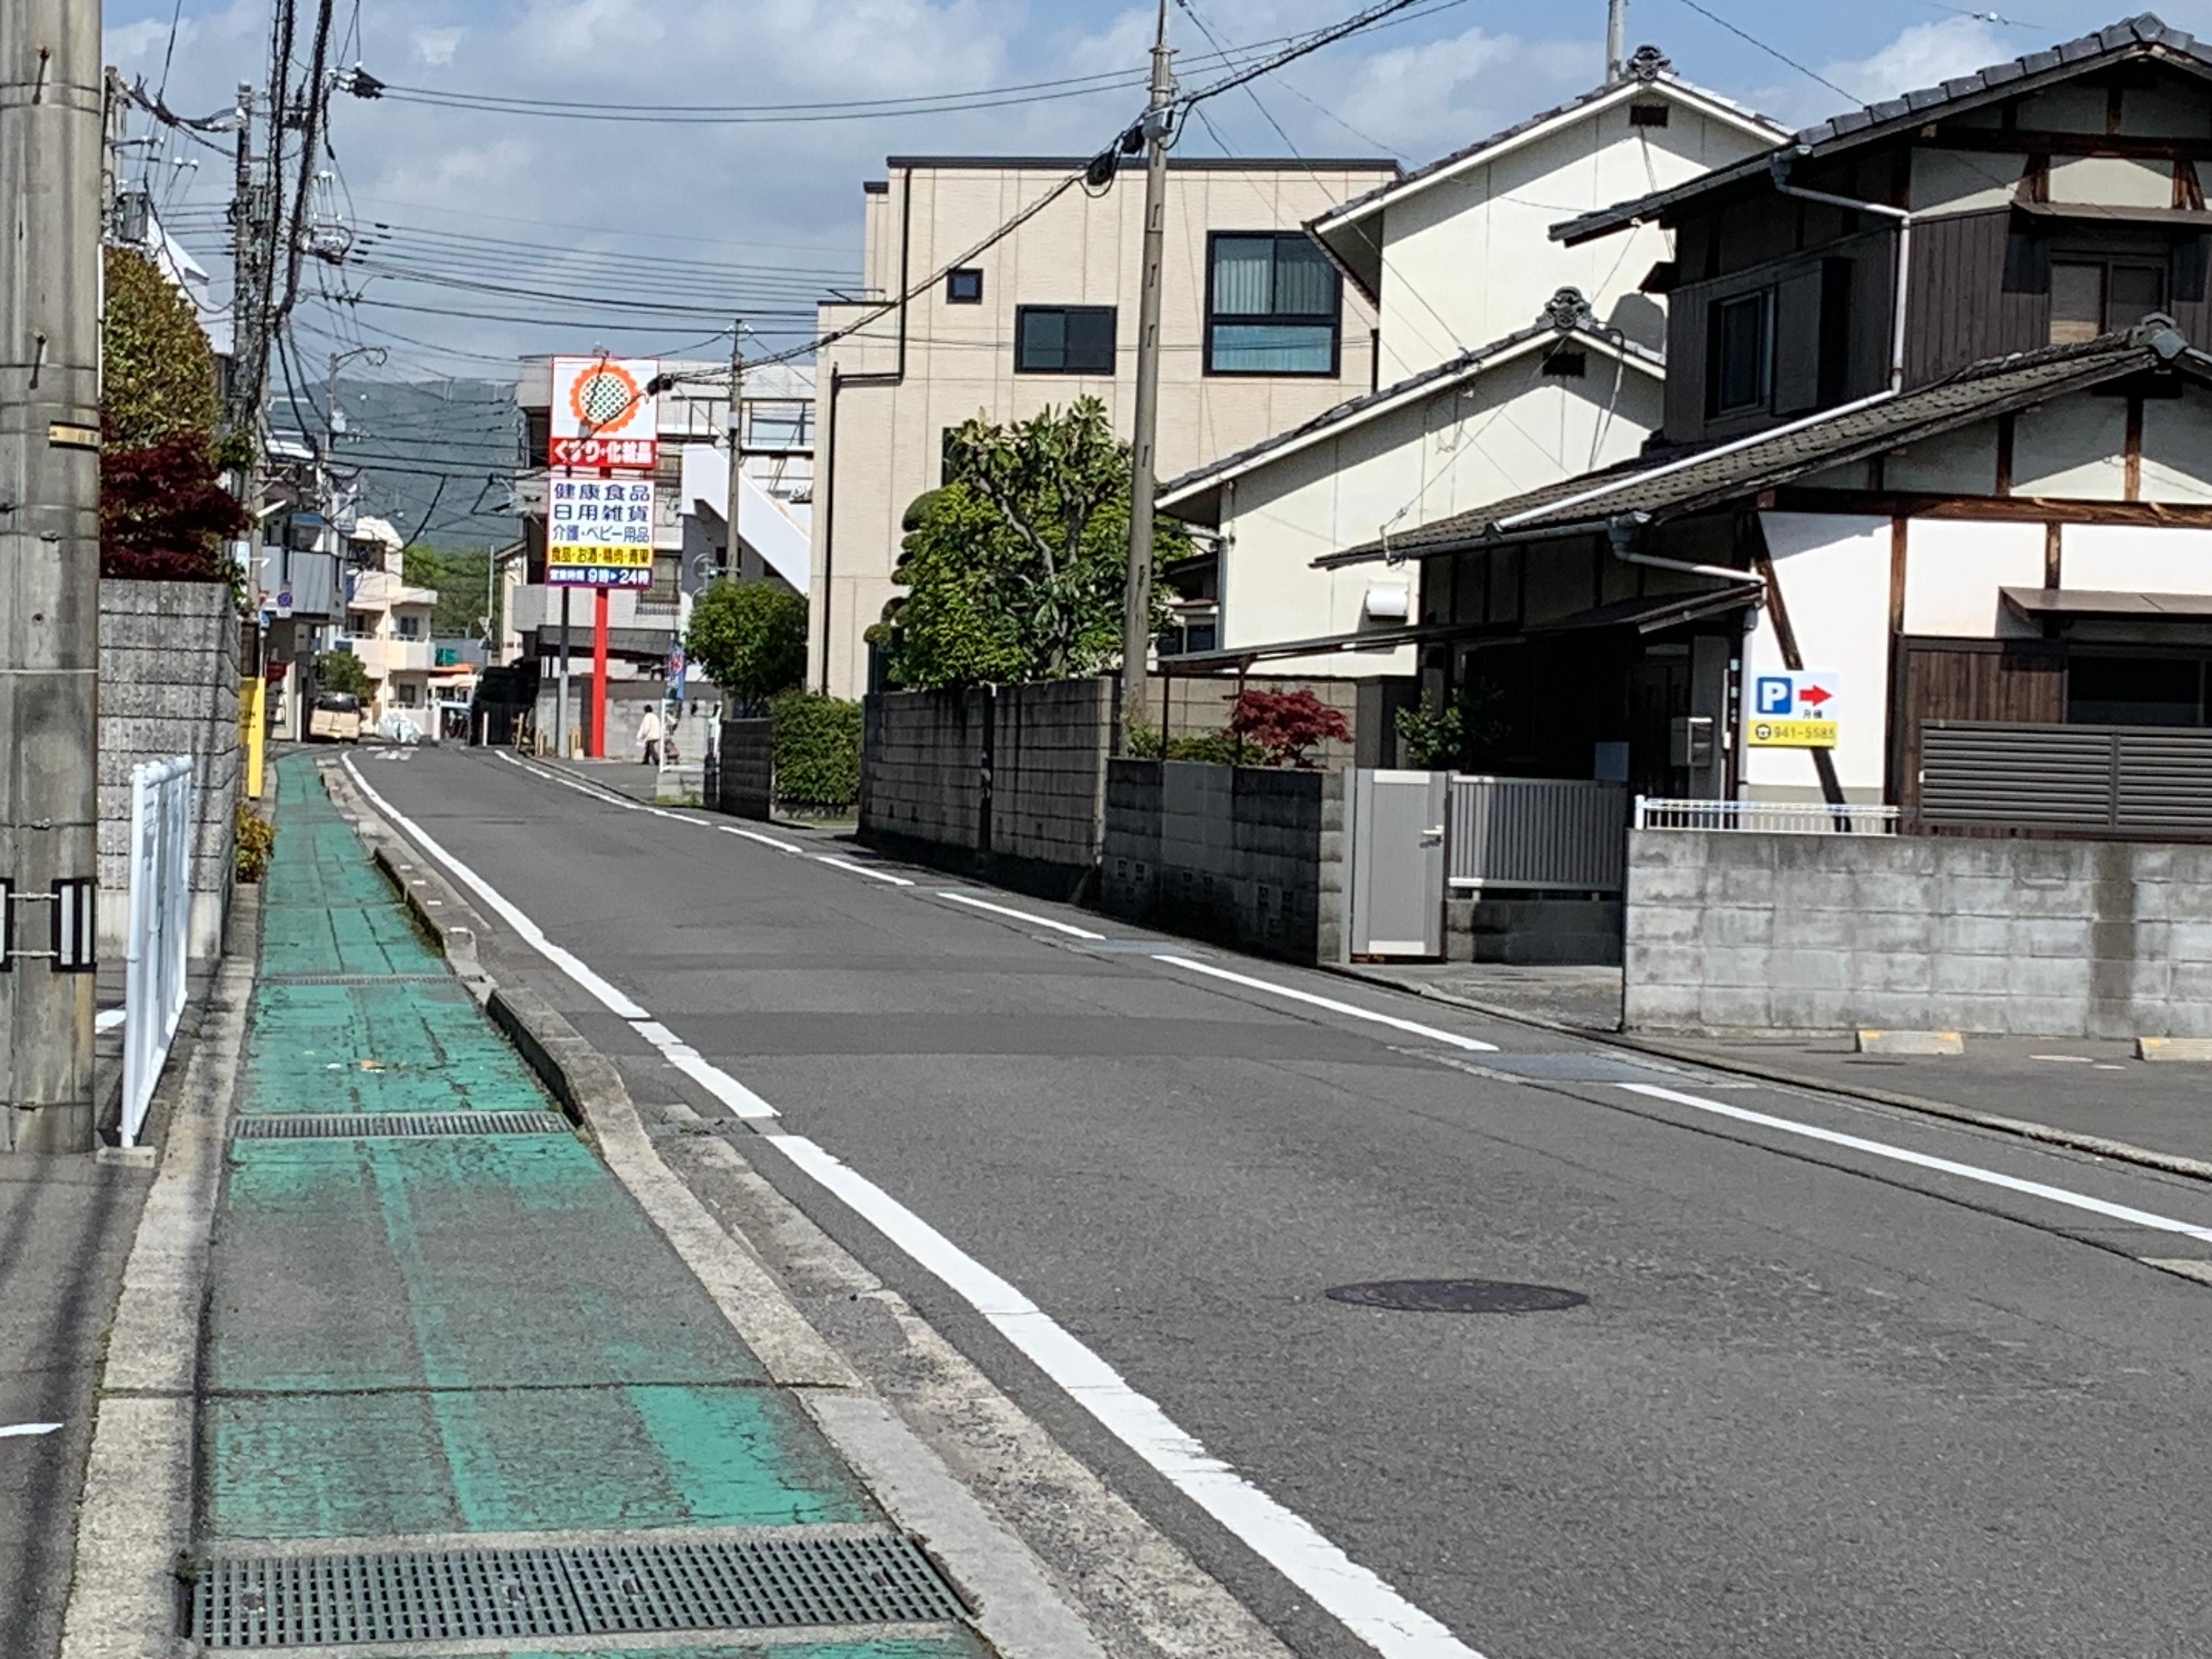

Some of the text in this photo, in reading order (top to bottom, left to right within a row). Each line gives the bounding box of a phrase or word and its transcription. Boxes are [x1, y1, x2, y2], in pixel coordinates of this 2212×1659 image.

[555, 483, 650, 501] 健康食品
[554, 504, 649, 522] 日用雑貨
[552, 524, 649, 543] 介護・ベビー用品
[1763, 681, 1787, 710] P
